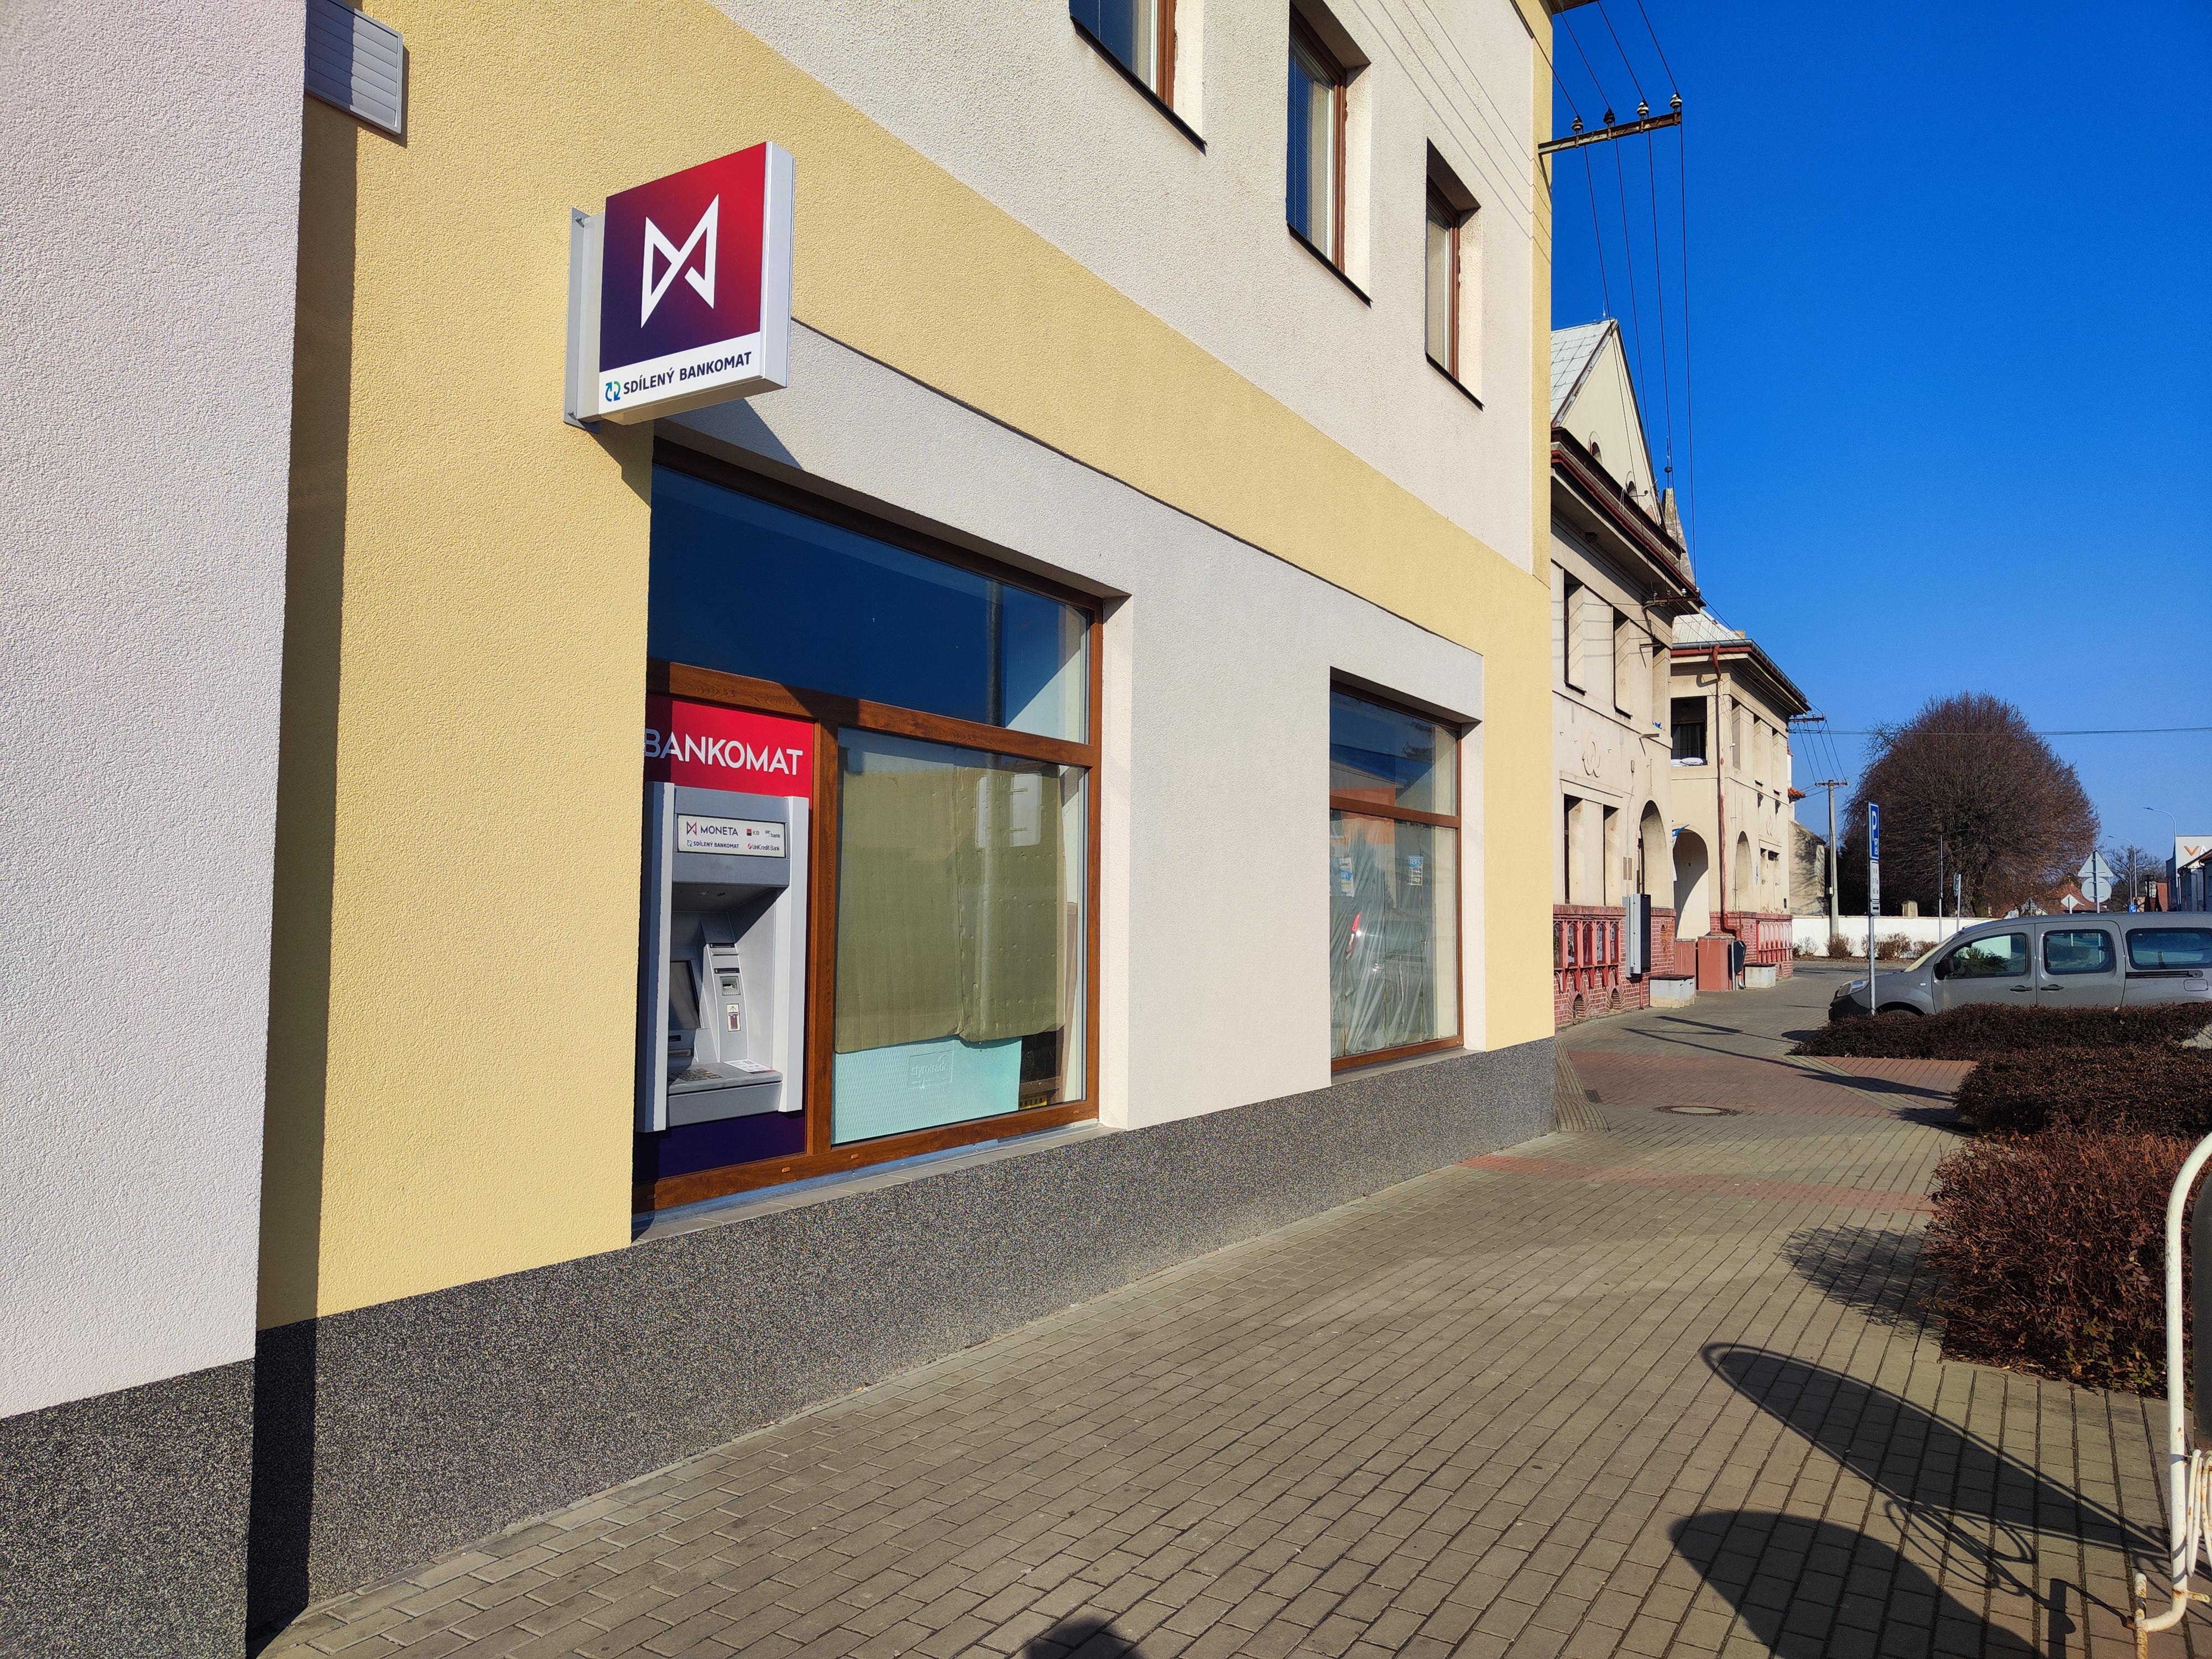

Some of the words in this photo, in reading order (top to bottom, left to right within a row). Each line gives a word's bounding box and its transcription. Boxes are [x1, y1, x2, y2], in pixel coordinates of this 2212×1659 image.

[623, 367, 675, 395] SDÍLENÝ
[680, 351, 752, 381] BANKOMAT
[645, 728, 804, 775] BANKOMAT
[700, 825, 739, 836] MONETA
